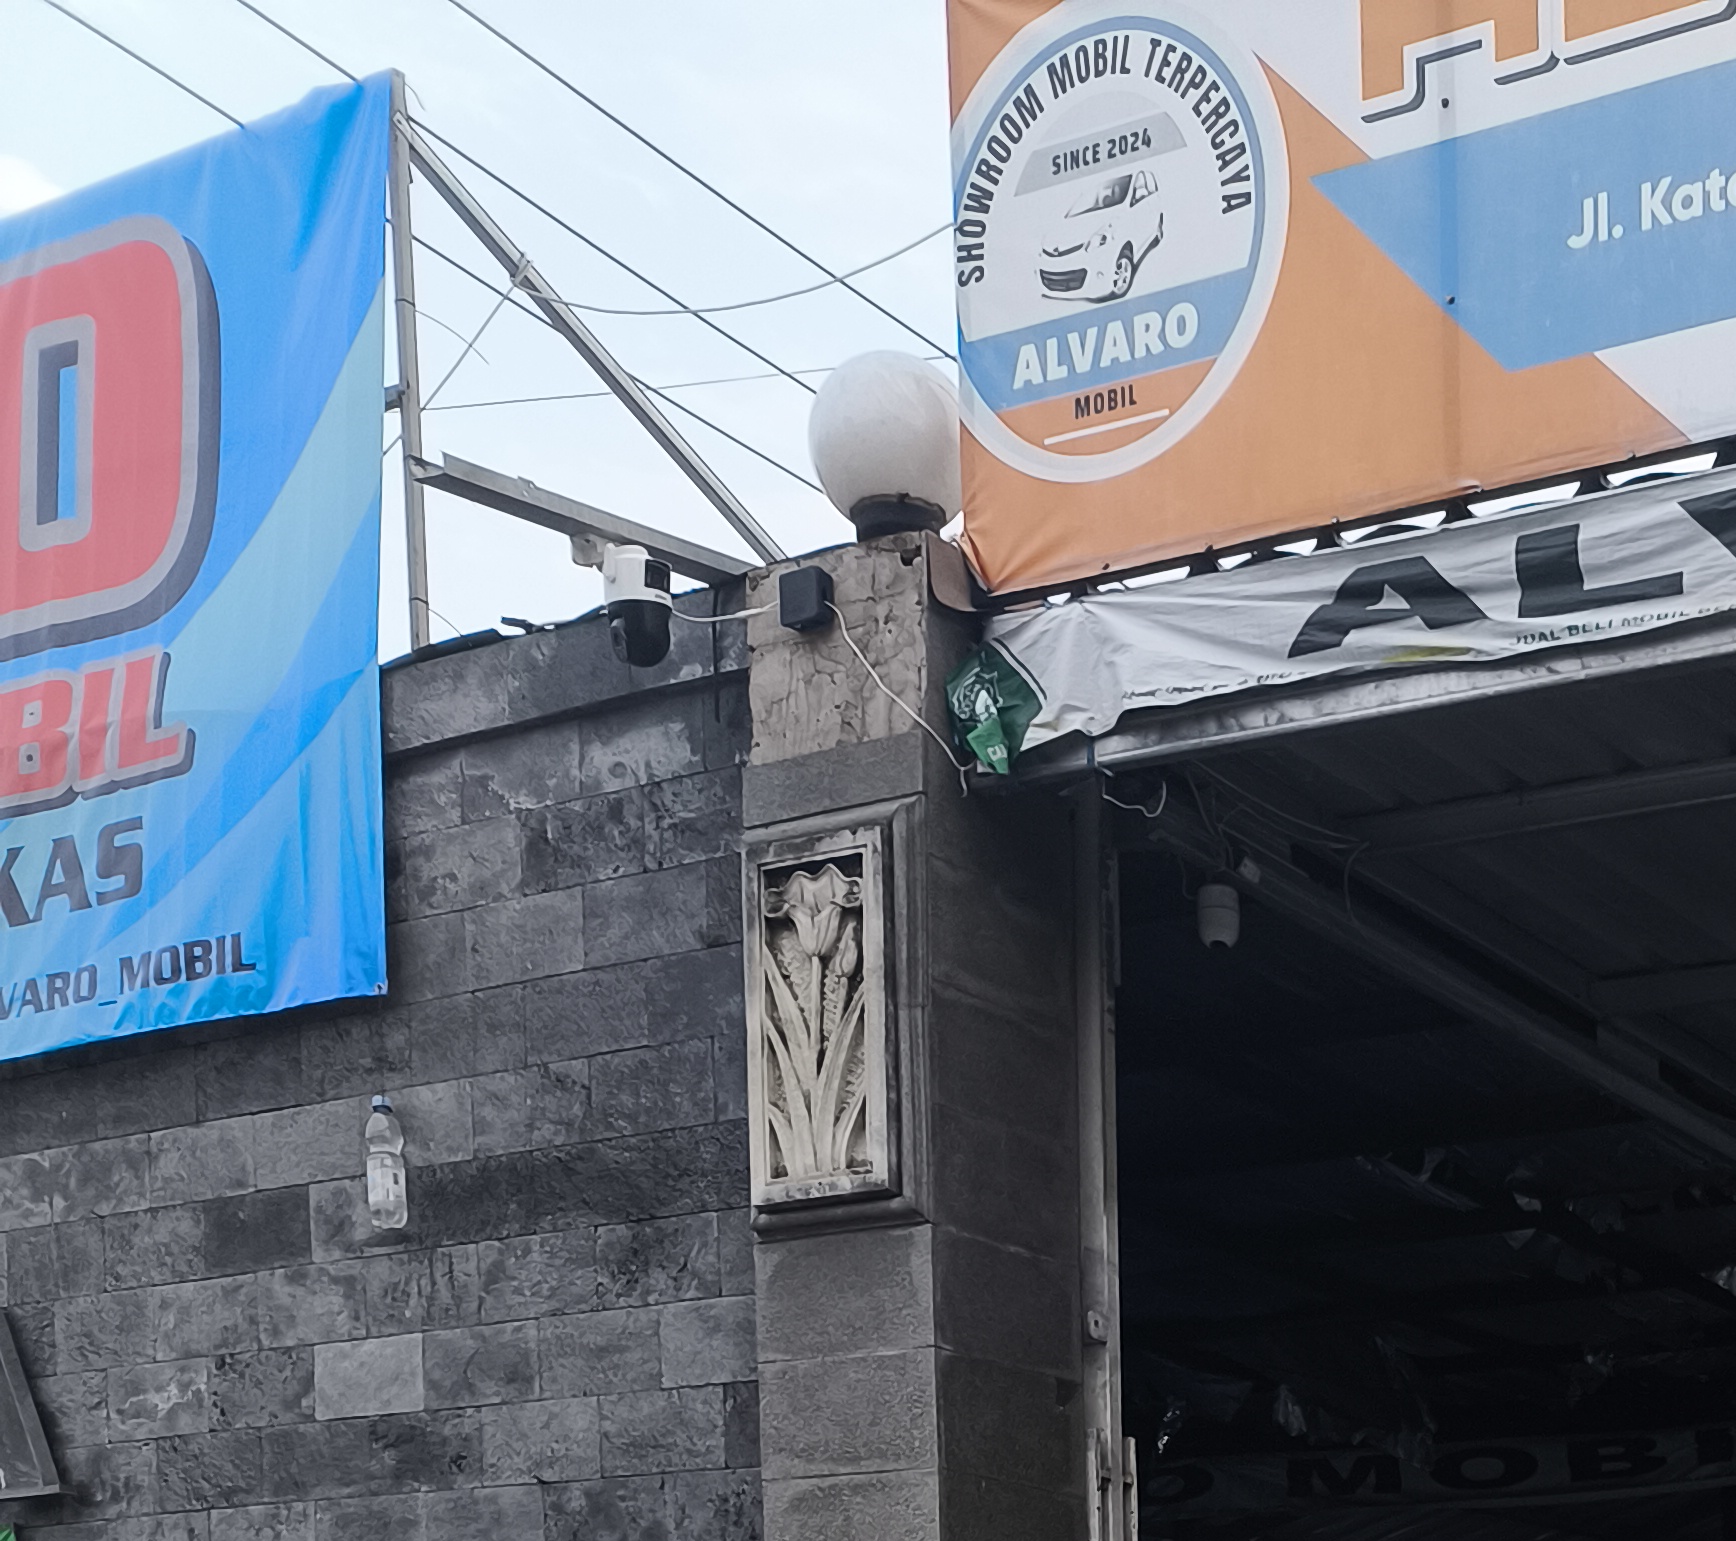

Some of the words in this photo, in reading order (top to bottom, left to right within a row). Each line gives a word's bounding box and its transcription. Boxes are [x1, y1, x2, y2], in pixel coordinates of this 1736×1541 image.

[957, 83, 1046, 285] SHOWROOM
[1047, 34, 1132, 100] MOBIL
[1143, 36, 1252, 215] TERPERCAYA
[1052, 138, 1101, 176] SINCE
[1106, 128, 1153, 161] 2024
[1566, 193, 1624, 249] Jl.
[1012, 302, 1199, 390] ALVARO
[1073, 384, 1138, 420] MOBIL
